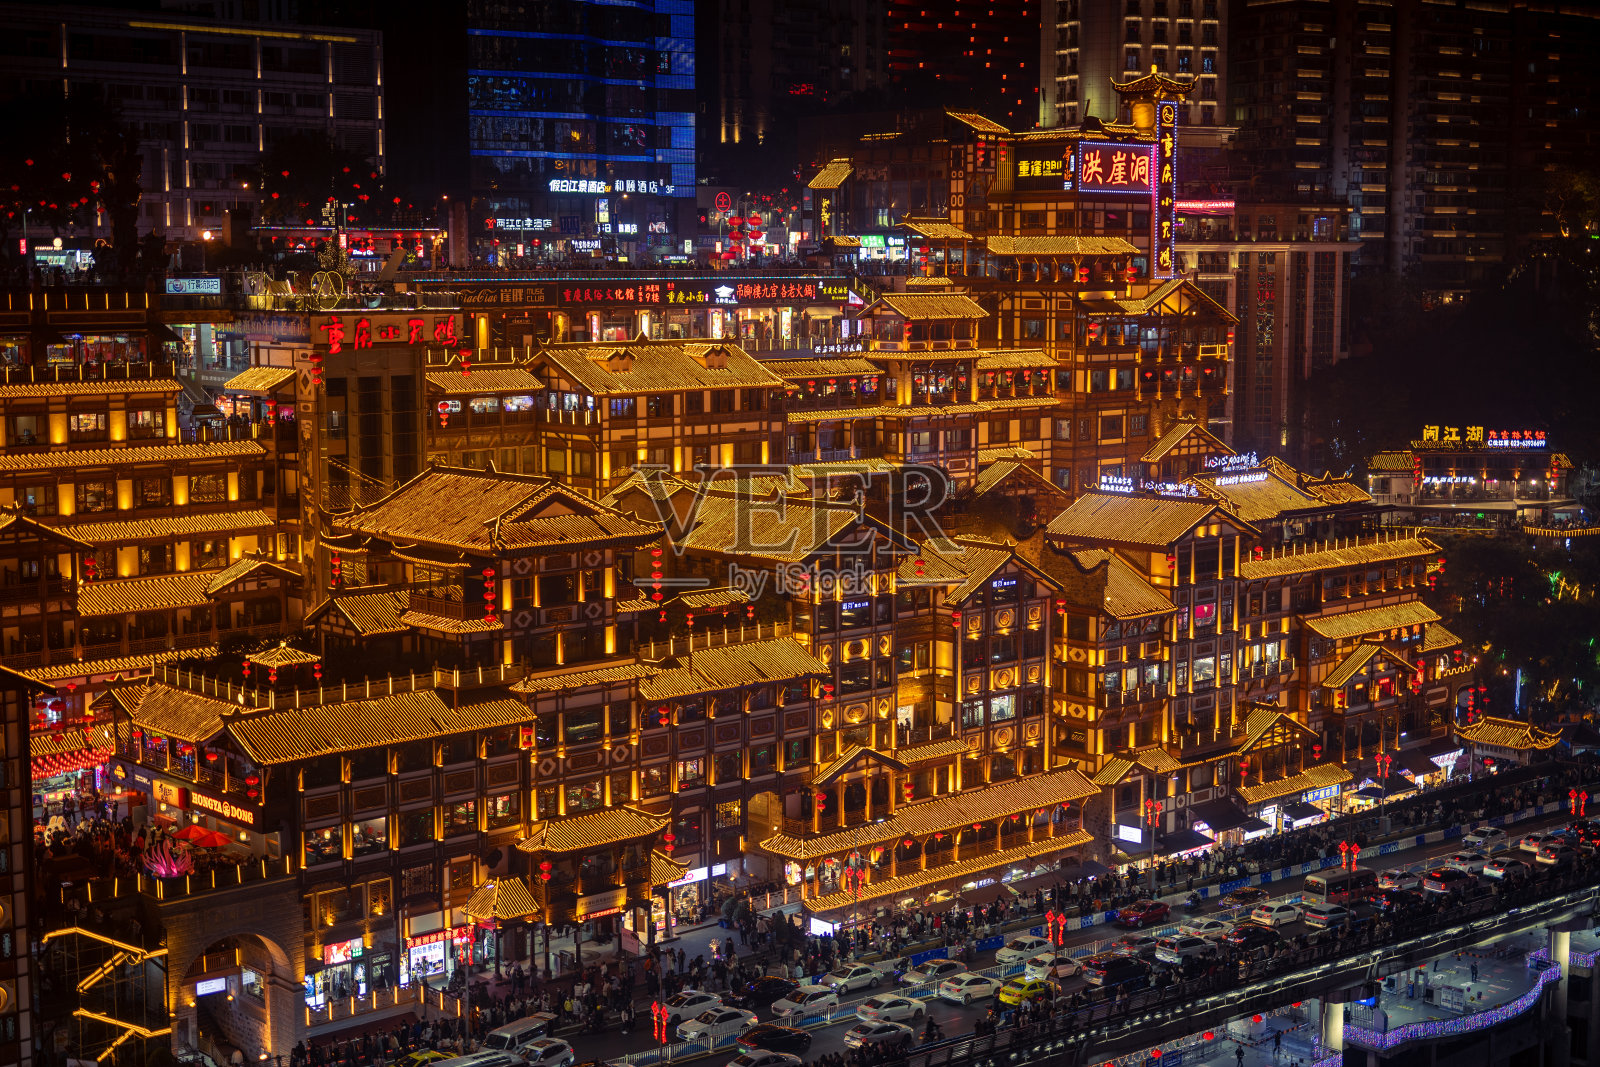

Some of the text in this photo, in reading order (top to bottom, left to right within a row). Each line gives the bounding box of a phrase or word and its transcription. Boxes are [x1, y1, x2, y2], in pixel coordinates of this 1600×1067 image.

[1082, 149, 1150, 186] 洪崖洞
[549, 180, 606, 193] 假日江景酒店
[1422, 424, 1484, 442] 闹江湖
[192, 792, 222, 814] HONGYA
[230, 806, 254, 824] DONG
